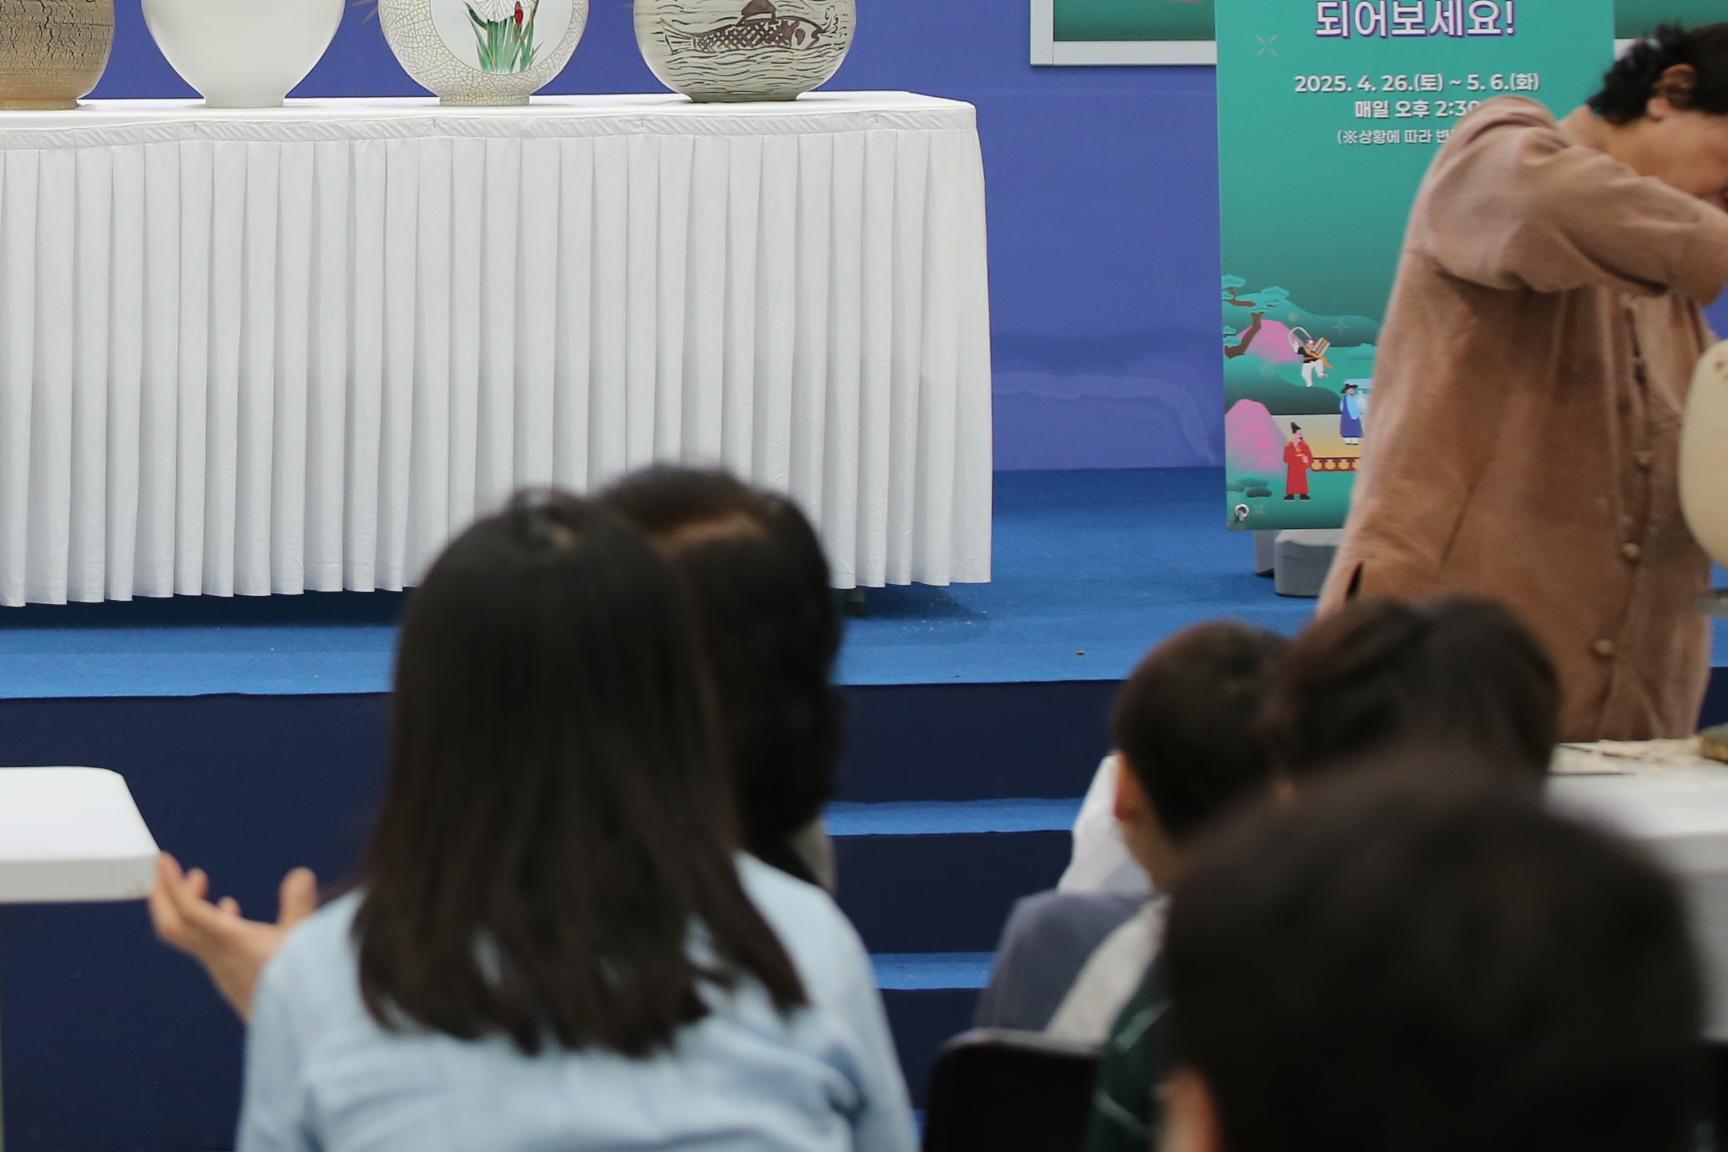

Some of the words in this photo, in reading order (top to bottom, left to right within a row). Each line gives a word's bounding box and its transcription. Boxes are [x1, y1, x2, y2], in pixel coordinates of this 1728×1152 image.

[1315, 0, 1516, 38] 되어보세요!
[1294, 76, 1353, 92] 2025.
[1357, 76, 1377, 92] 4.
[1466, 75, 1485, 91] 5.
[1354, 100, 1389, 118] 매일
[1395, 99, 1430, 118] 오후
[1404, 129, 1433, 144] 따라
